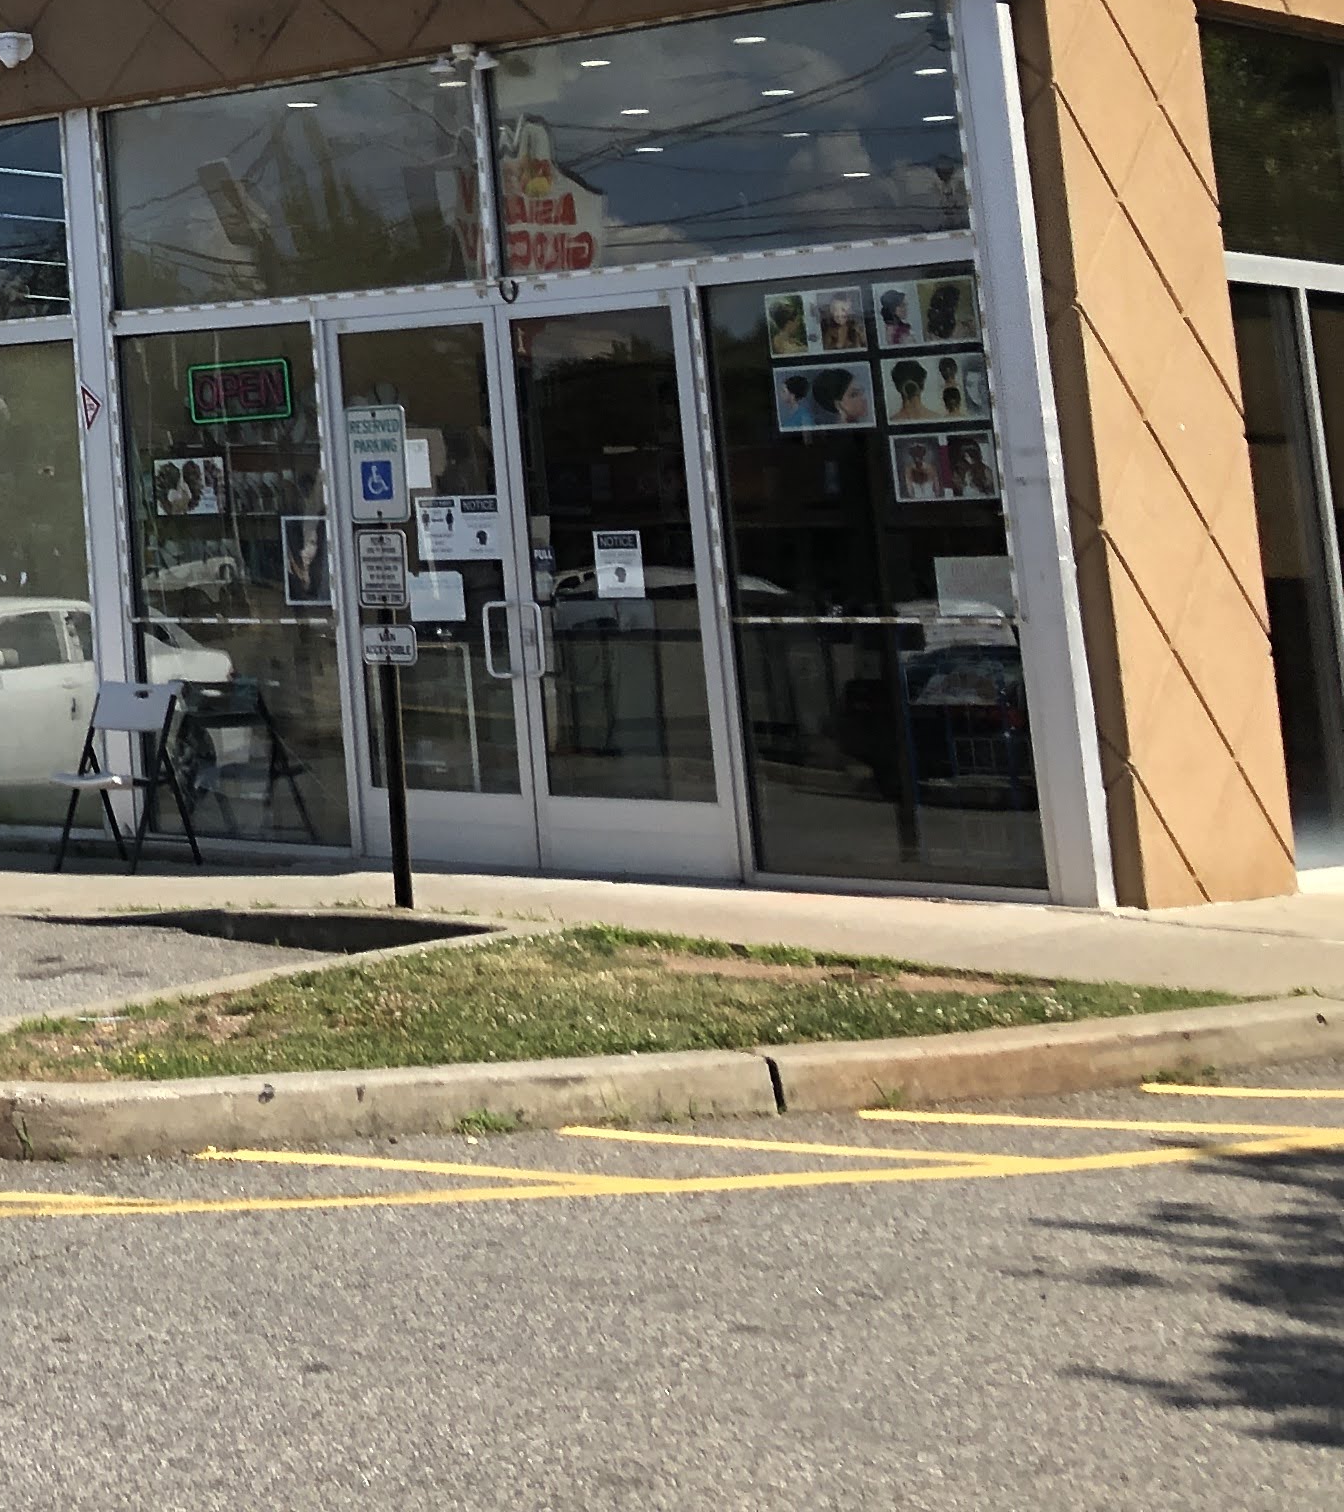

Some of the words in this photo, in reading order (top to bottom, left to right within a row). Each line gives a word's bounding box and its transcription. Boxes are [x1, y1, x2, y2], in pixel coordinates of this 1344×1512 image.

[196, 370, 283, 411] OPEN
[351, 419, 399, 434] RESERVED
[354, 438, 398, 454] PARKING
[462, 499, 496, 512] NOTICE
[599, 536, 635, 547] NOTICE
[534, 548, 553, 559] PULL
